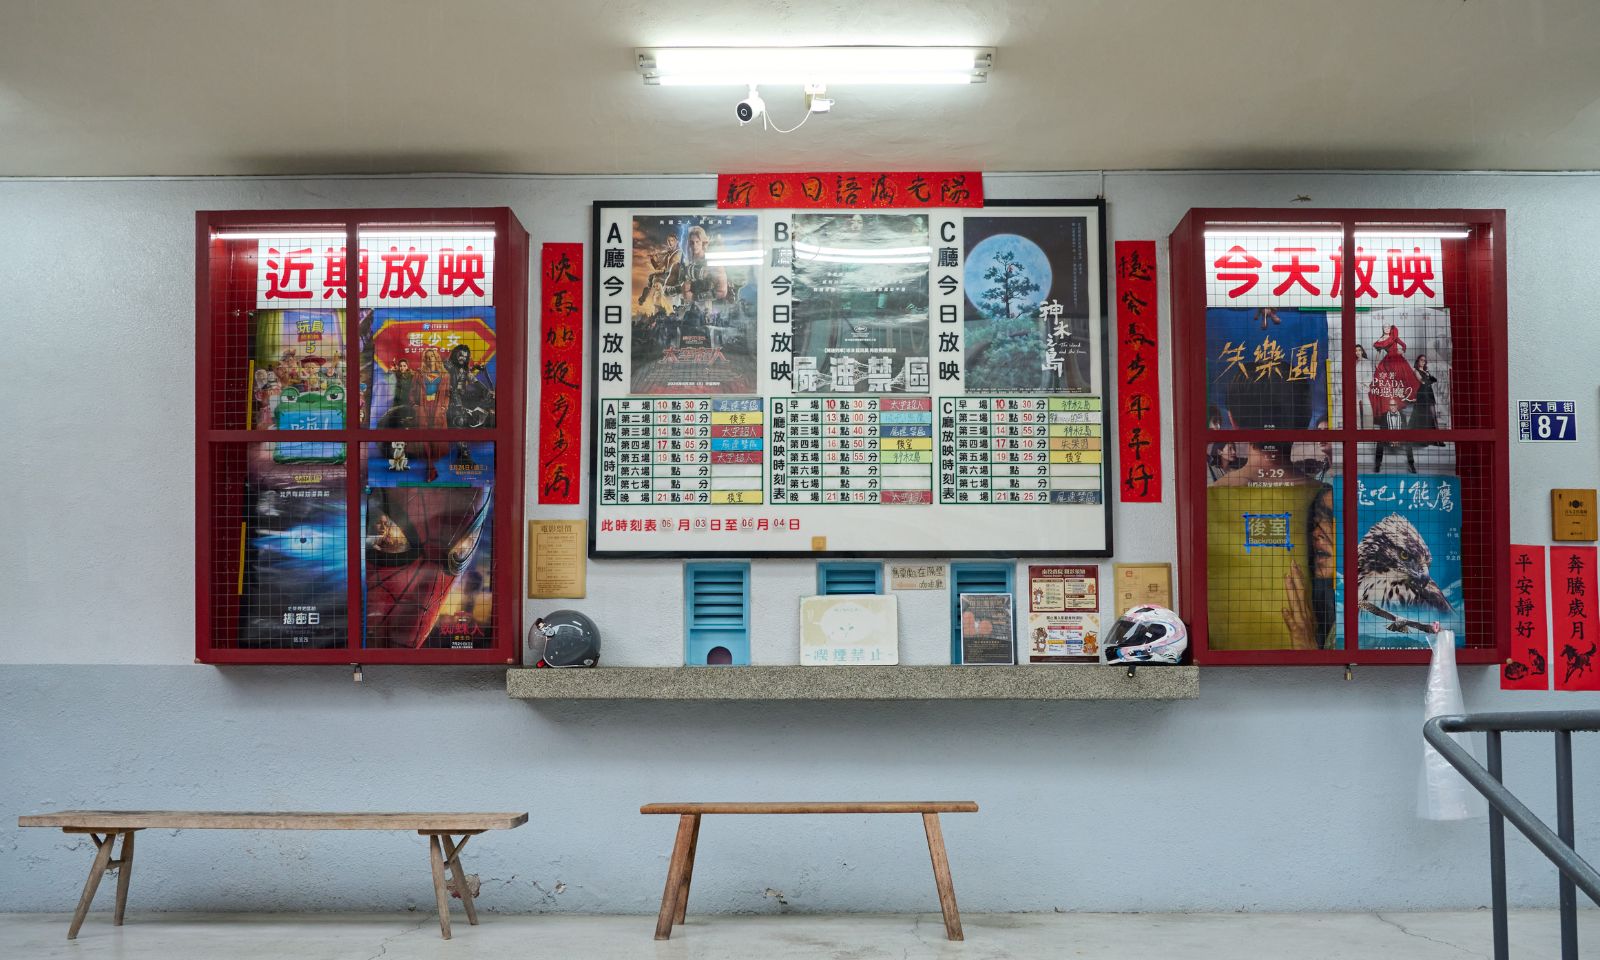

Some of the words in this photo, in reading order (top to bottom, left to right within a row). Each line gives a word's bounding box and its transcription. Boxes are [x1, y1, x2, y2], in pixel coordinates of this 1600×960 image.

[265, 246, 486, 299] 近期放映
[1214, 245, 1435, 299] 今天放映
[602, 222, 625, 382] A廳今日放映
[938, 221, 960, 381] C廳今日放映
[408, 332, 462, 347] 超少女
[1039, 299, 1072, 378] 神木之島
[1214, 335, 1319, 384] 失樂園
[793, 356, 929, 392] 屍速禁區
[1372, 379, 1405, 387] PRADA
[1532, 402, 1574, 412] 大同街
[620, 415, 650, 423] 第二場
[790, 413, 819, 422] 第二場
[959, 413, 988, 422] 第二場
[790, 426, 819, 435] 第三場
[959, 426, 988, 435] 第三場
[1538, 415, 1568, 438] 87
[620, 427, 650, 436] 第三場
[620, 440, 650, 449] 第四場
[790, 440, 819, 448] 第四場
[959, 439, 988, 448] 第四場
[603, 403, 617, 501] A廳放映時刻表
[773, 402, 785, 500] B廳放映時刻表
[942, 402, 954, 500] C廳放映時刻表
[620, 454, 650, 462] 第五場
[790, 452, 819, 462] 第五場
[959, 452, 988, 461] 第五場
[620, 467, 650, 476] 第六場
[790, 466, 819, 475] 第六場
[959, 466, 988, 475] 第六場
[620, 480, 650, 489] 第七場
[790, 479, 819, 488] 第七場
[959, 479, 988, 488] 第七場
[1249, 518, 1287, 536] 後室
[1515, 554, 1535, 639] 平安靜好
[1567, 554, 1587, 640] 奔騰歲月
[283, 613, 320, 625] 揭密日
